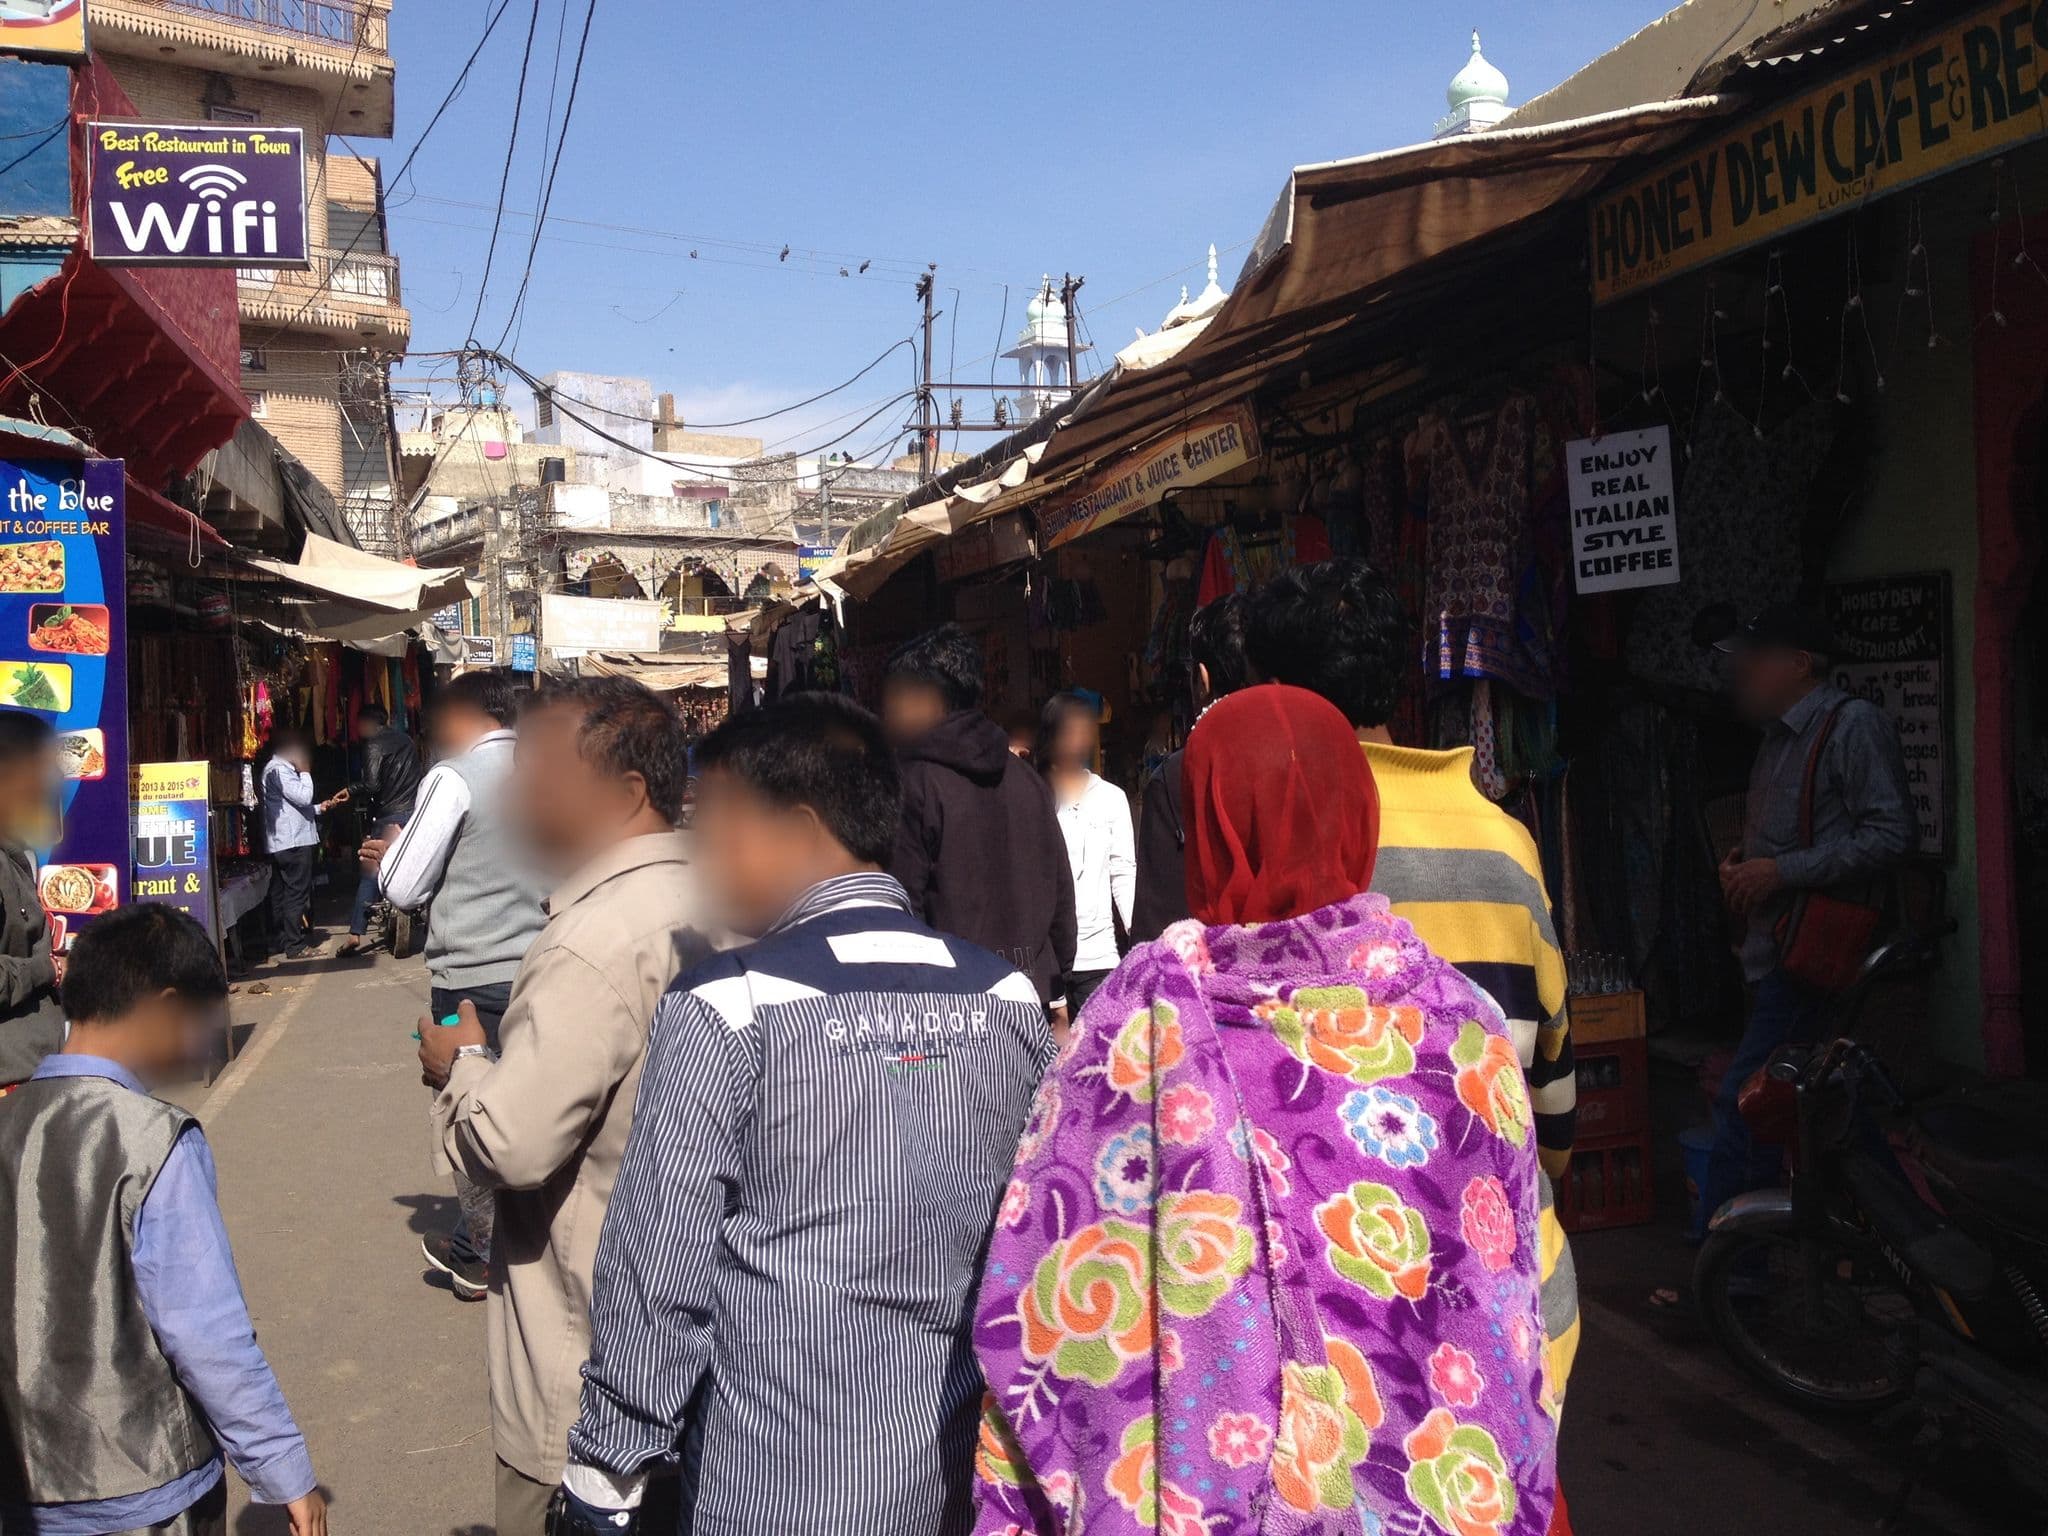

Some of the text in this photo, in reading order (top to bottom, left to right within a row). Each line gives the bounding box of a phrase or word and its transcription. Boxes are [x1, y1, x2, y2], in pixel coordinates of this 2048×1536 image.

[100, 130, 290, 155] Best Restaurant in Town
[115, 160, 169, 190] Free
[1594, 153, 1719, 282] HONEY
[1725, 106, 1817, 227] DEW
[1821, 46, 1950, 185] CAFE
[1817, 177, 1875, 211] LUNCH
[109, 200, 278, 253] Wifi
[1071, 475, 1134, 521] RESTAURANT
[1135, 471, 1146, 493] &
[1146, 454, 1182, 489] JUICE
[1185, 422, 1239, 470] CENTER
[1580, 445, 1658, 474] ENJOY
[8, 478, 48, 513] the
[1591, 474, 1651, 498] REAL
[1575, 496, 1670, 528] ITALIAN
[13, 520, 24, 534] &
[26, 520, 78, 535] COFFEE
[81, 521, 110, 535] BAR
[1583, 525, 1666, 553] STYLE
[1579, 548, 1673, 578] COFFEE
[1841, 585, 1923, 615] HONEY DEW
[1862, 615, 1901, 632] CAFE
[1894, 664, 1932, 688] garlic
[141, 782, 159, 792] 2013
[160, 782, 166, 791] &
[167, 781, 185, 791] 2015
[155, 792, 184, 800] routard
[155, 819, 196, 834] THE
[184, 872, 201, 893] &
[825, 1011, 988, 1040] GANADOR
